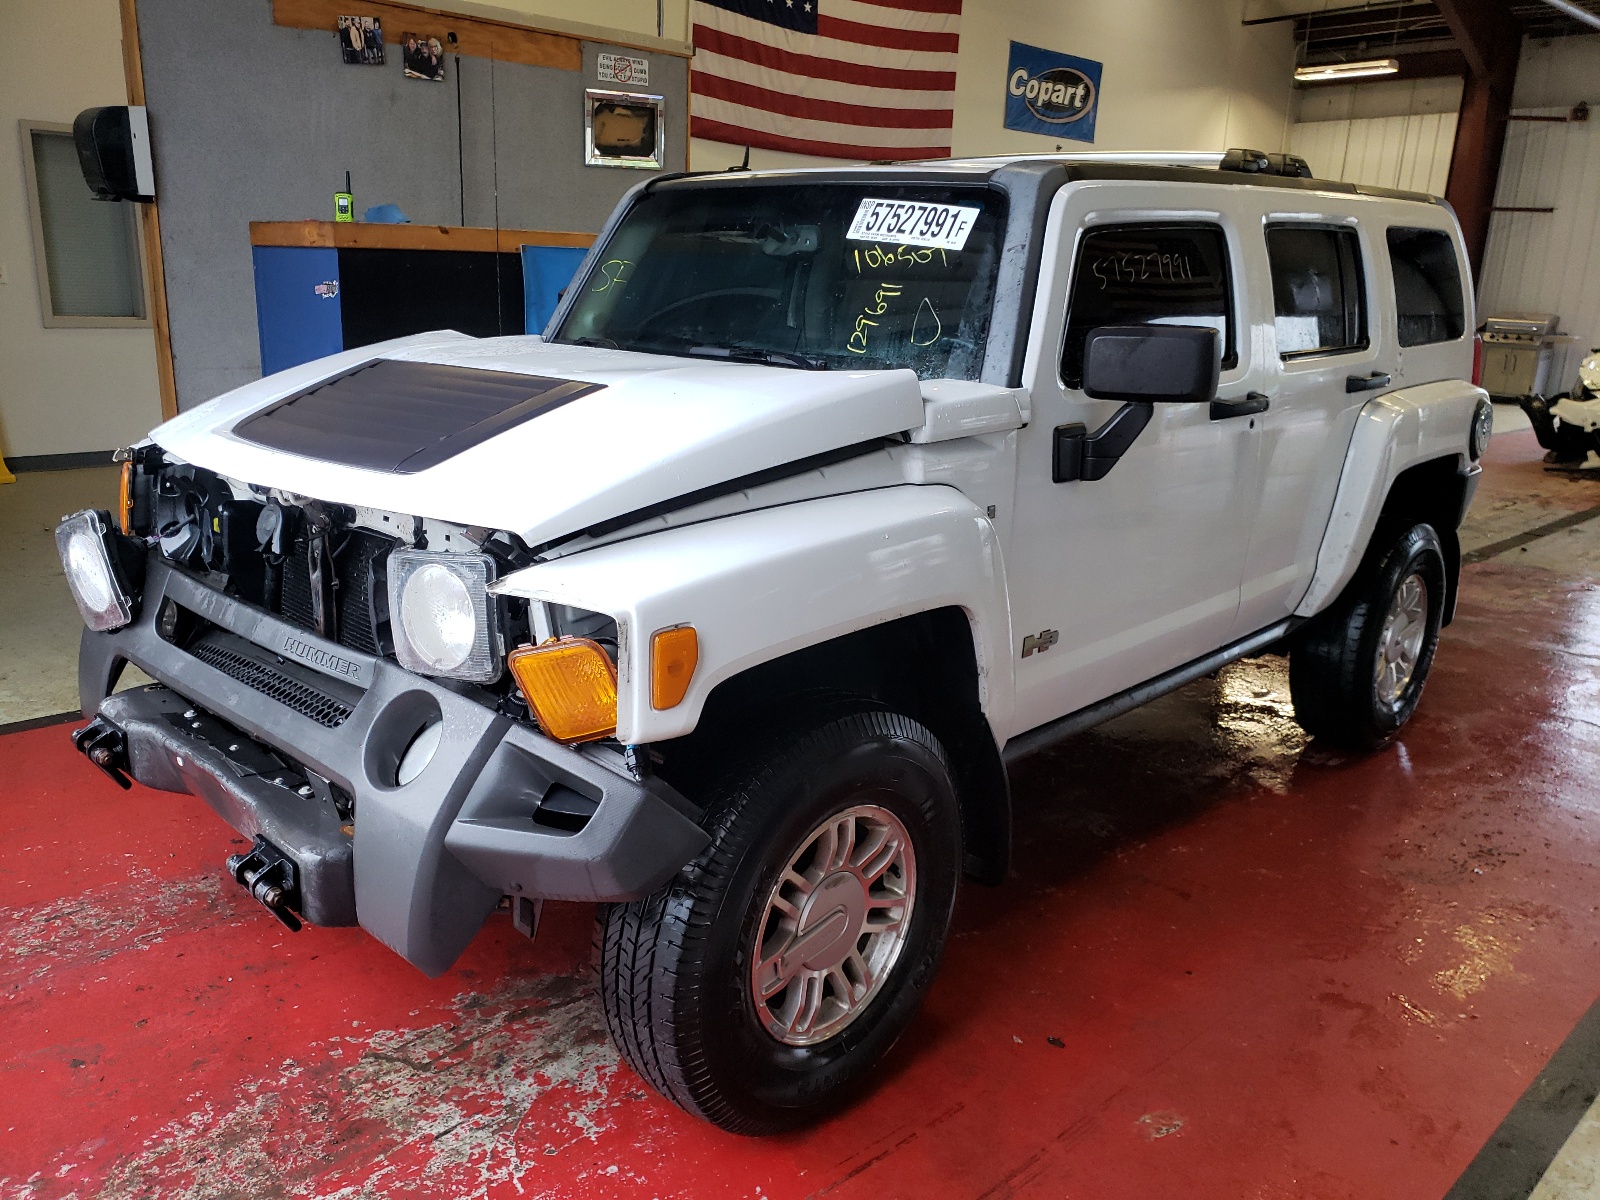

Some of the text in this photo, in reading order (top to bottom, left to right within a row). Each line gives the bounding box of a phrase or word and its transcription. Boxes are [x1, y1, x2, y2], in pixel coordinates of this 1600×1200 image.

[1009, 68, 1086, 108] Copart
[1092, 252, 1192, 289] 57527991
[284, 637, 361, 680] HUMMER
[1021, 629, 1060, 658] H3
